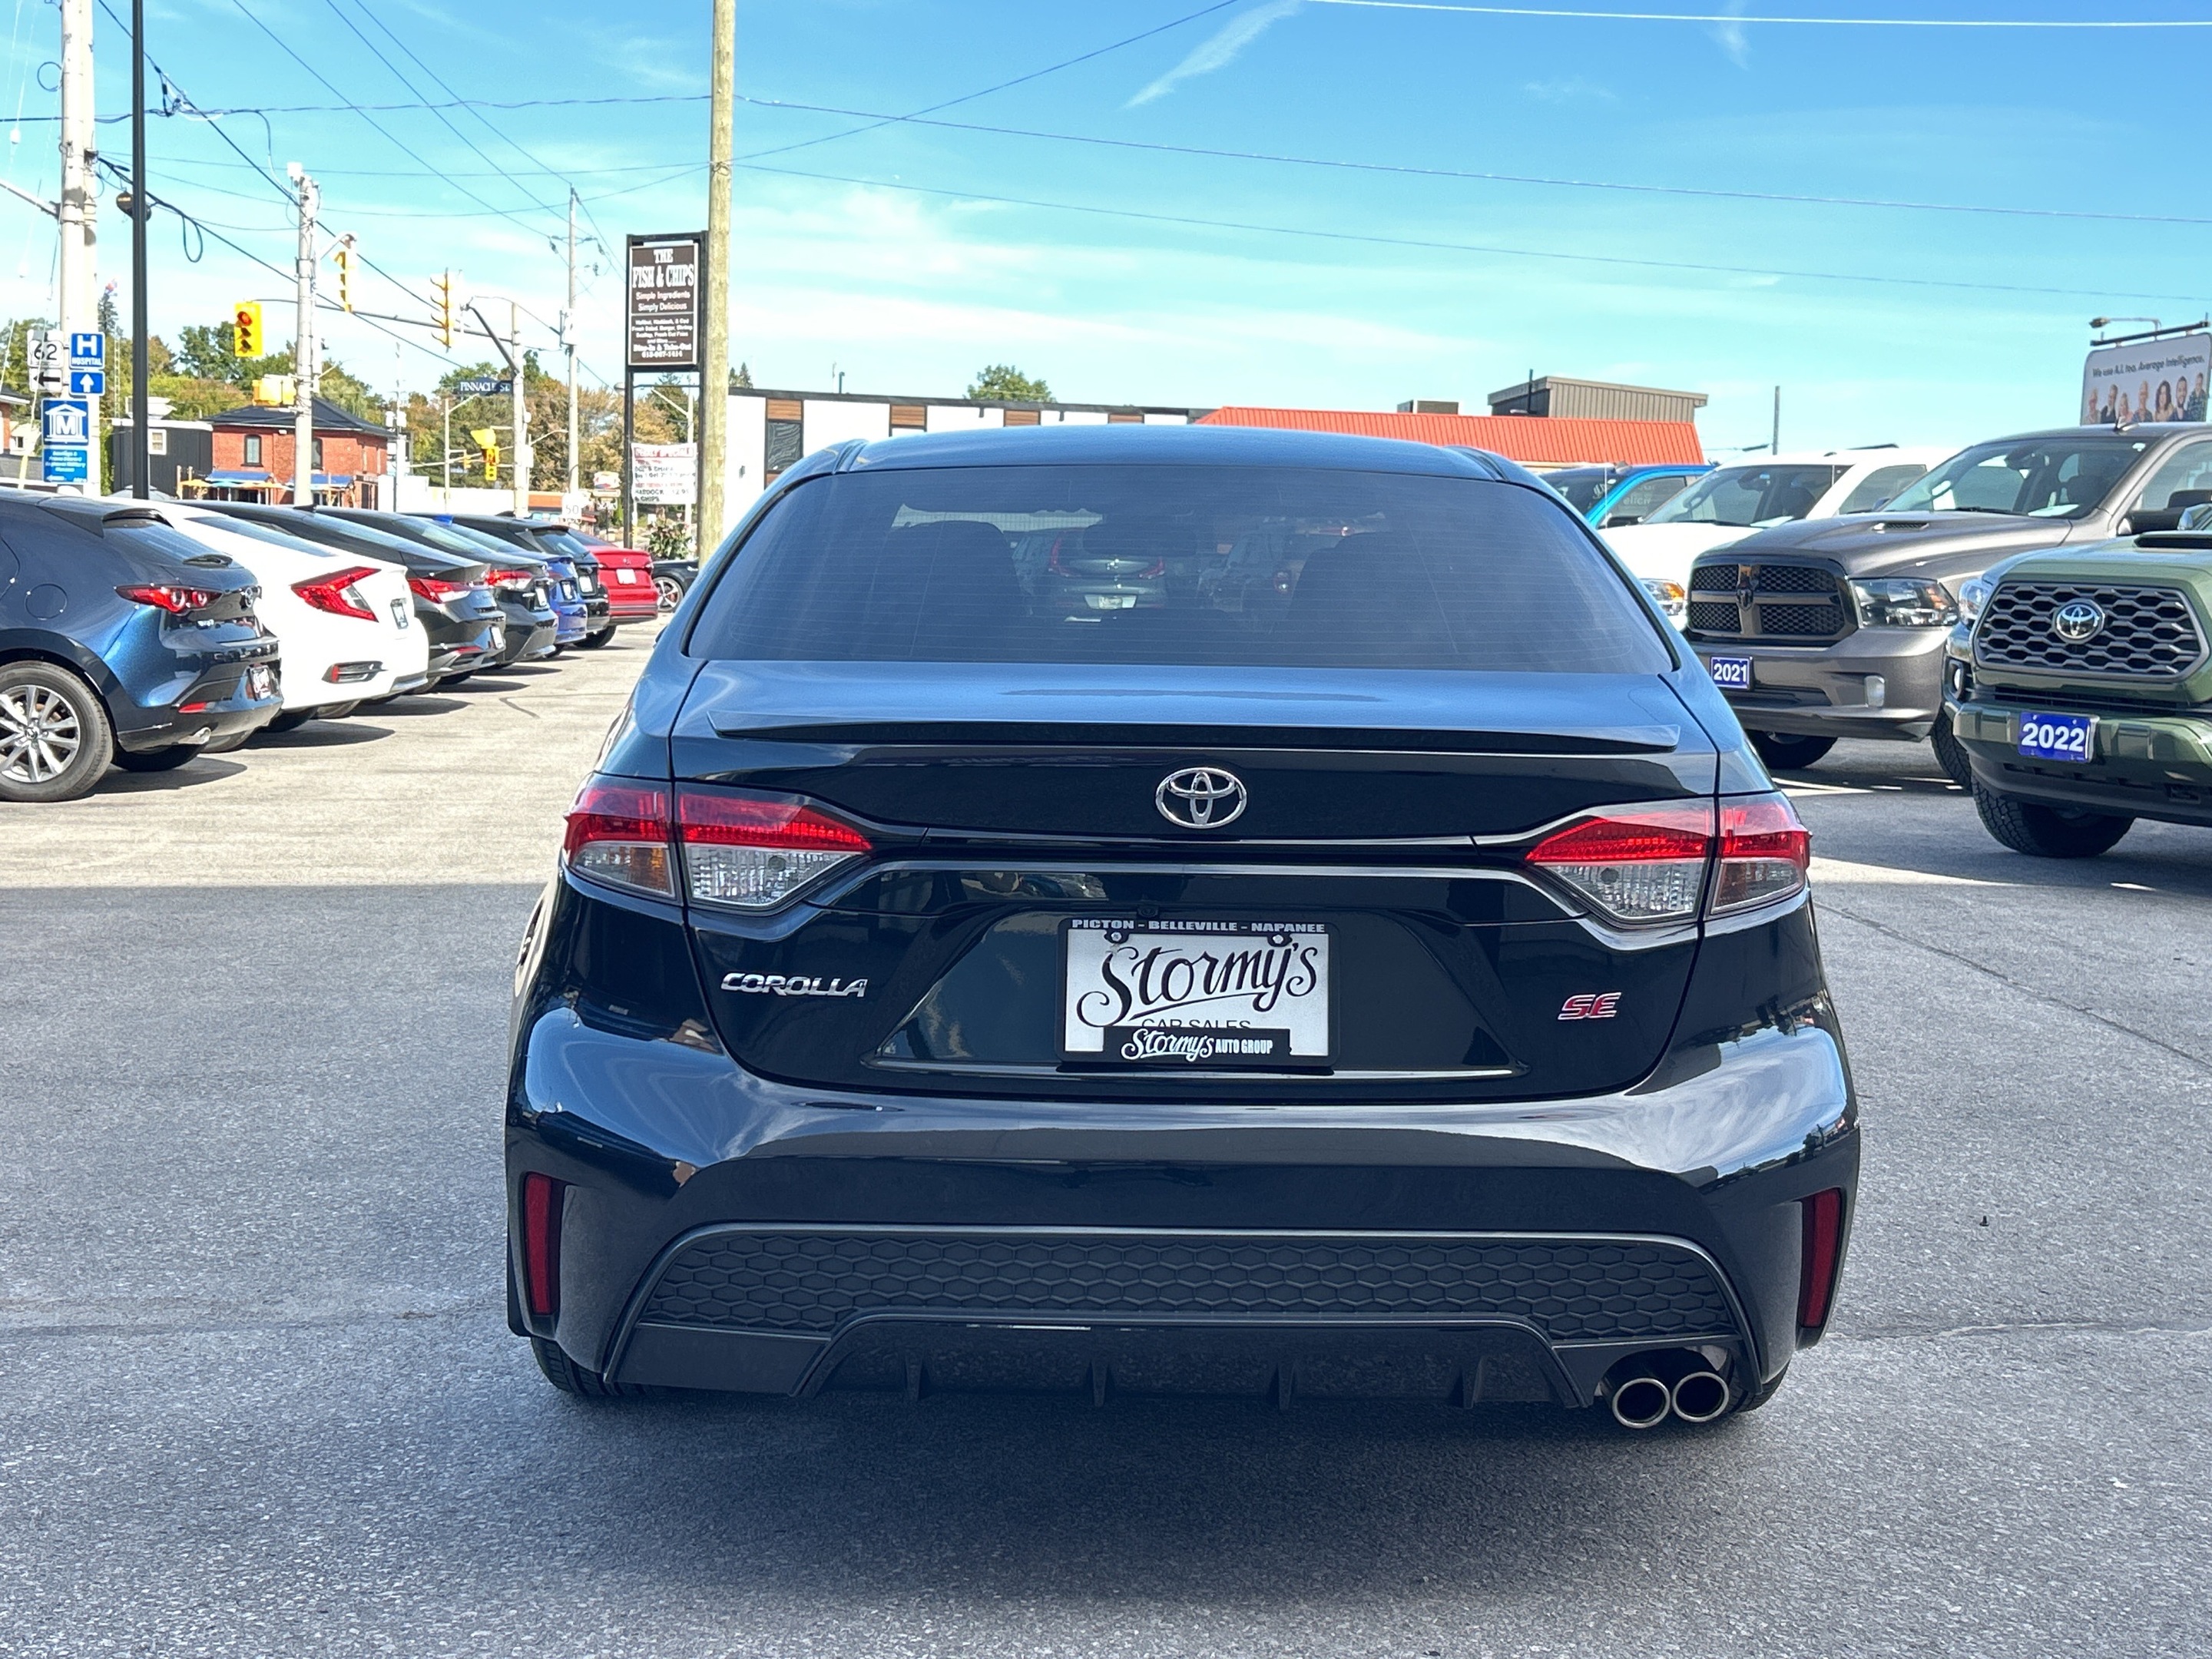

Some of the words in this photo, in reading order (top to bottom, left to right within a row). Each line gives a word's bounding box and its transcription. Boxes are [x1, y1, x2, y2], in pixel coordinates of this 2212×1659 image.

[654, 248, 674, 263] THE
[632, 266, 655, 288] FISH
[656, 265, 664, 287] &
[666, 263, 694, 288] CHIPS
[636, 291, 656, 301] Simple
[657, 290, 690, 300] Ingredients
[637, 303, 658, 313] Simply
[659, 302, 687, 310] Delicious
[34, 343, 58, 361] 62
[77, 335, 98, 356] H
[71, 356, 102, 366] HOSPITAL
[565, 505, 579, 515] 50
[1714, 663, 1747, 683] 2021
[2021, 722, 2085, 753] 2022
[1071, 919, 1134, 929] PICTON
[1148, 920, 1238, 932] BELLEVILLE
[1251, 922, 1325, 933] NAPANEE
[720, 972, 869, 998] COROLLA
[1076, 942, 1318, 1028] Stormy's
[1558, 992, 1622, 1021] SE
[1121, 1028, 1214, 1062] Stormy's
[1215, 1038, 1240, 1054] AUTO
[1240, 1039, 1273, 1055] GROUP
